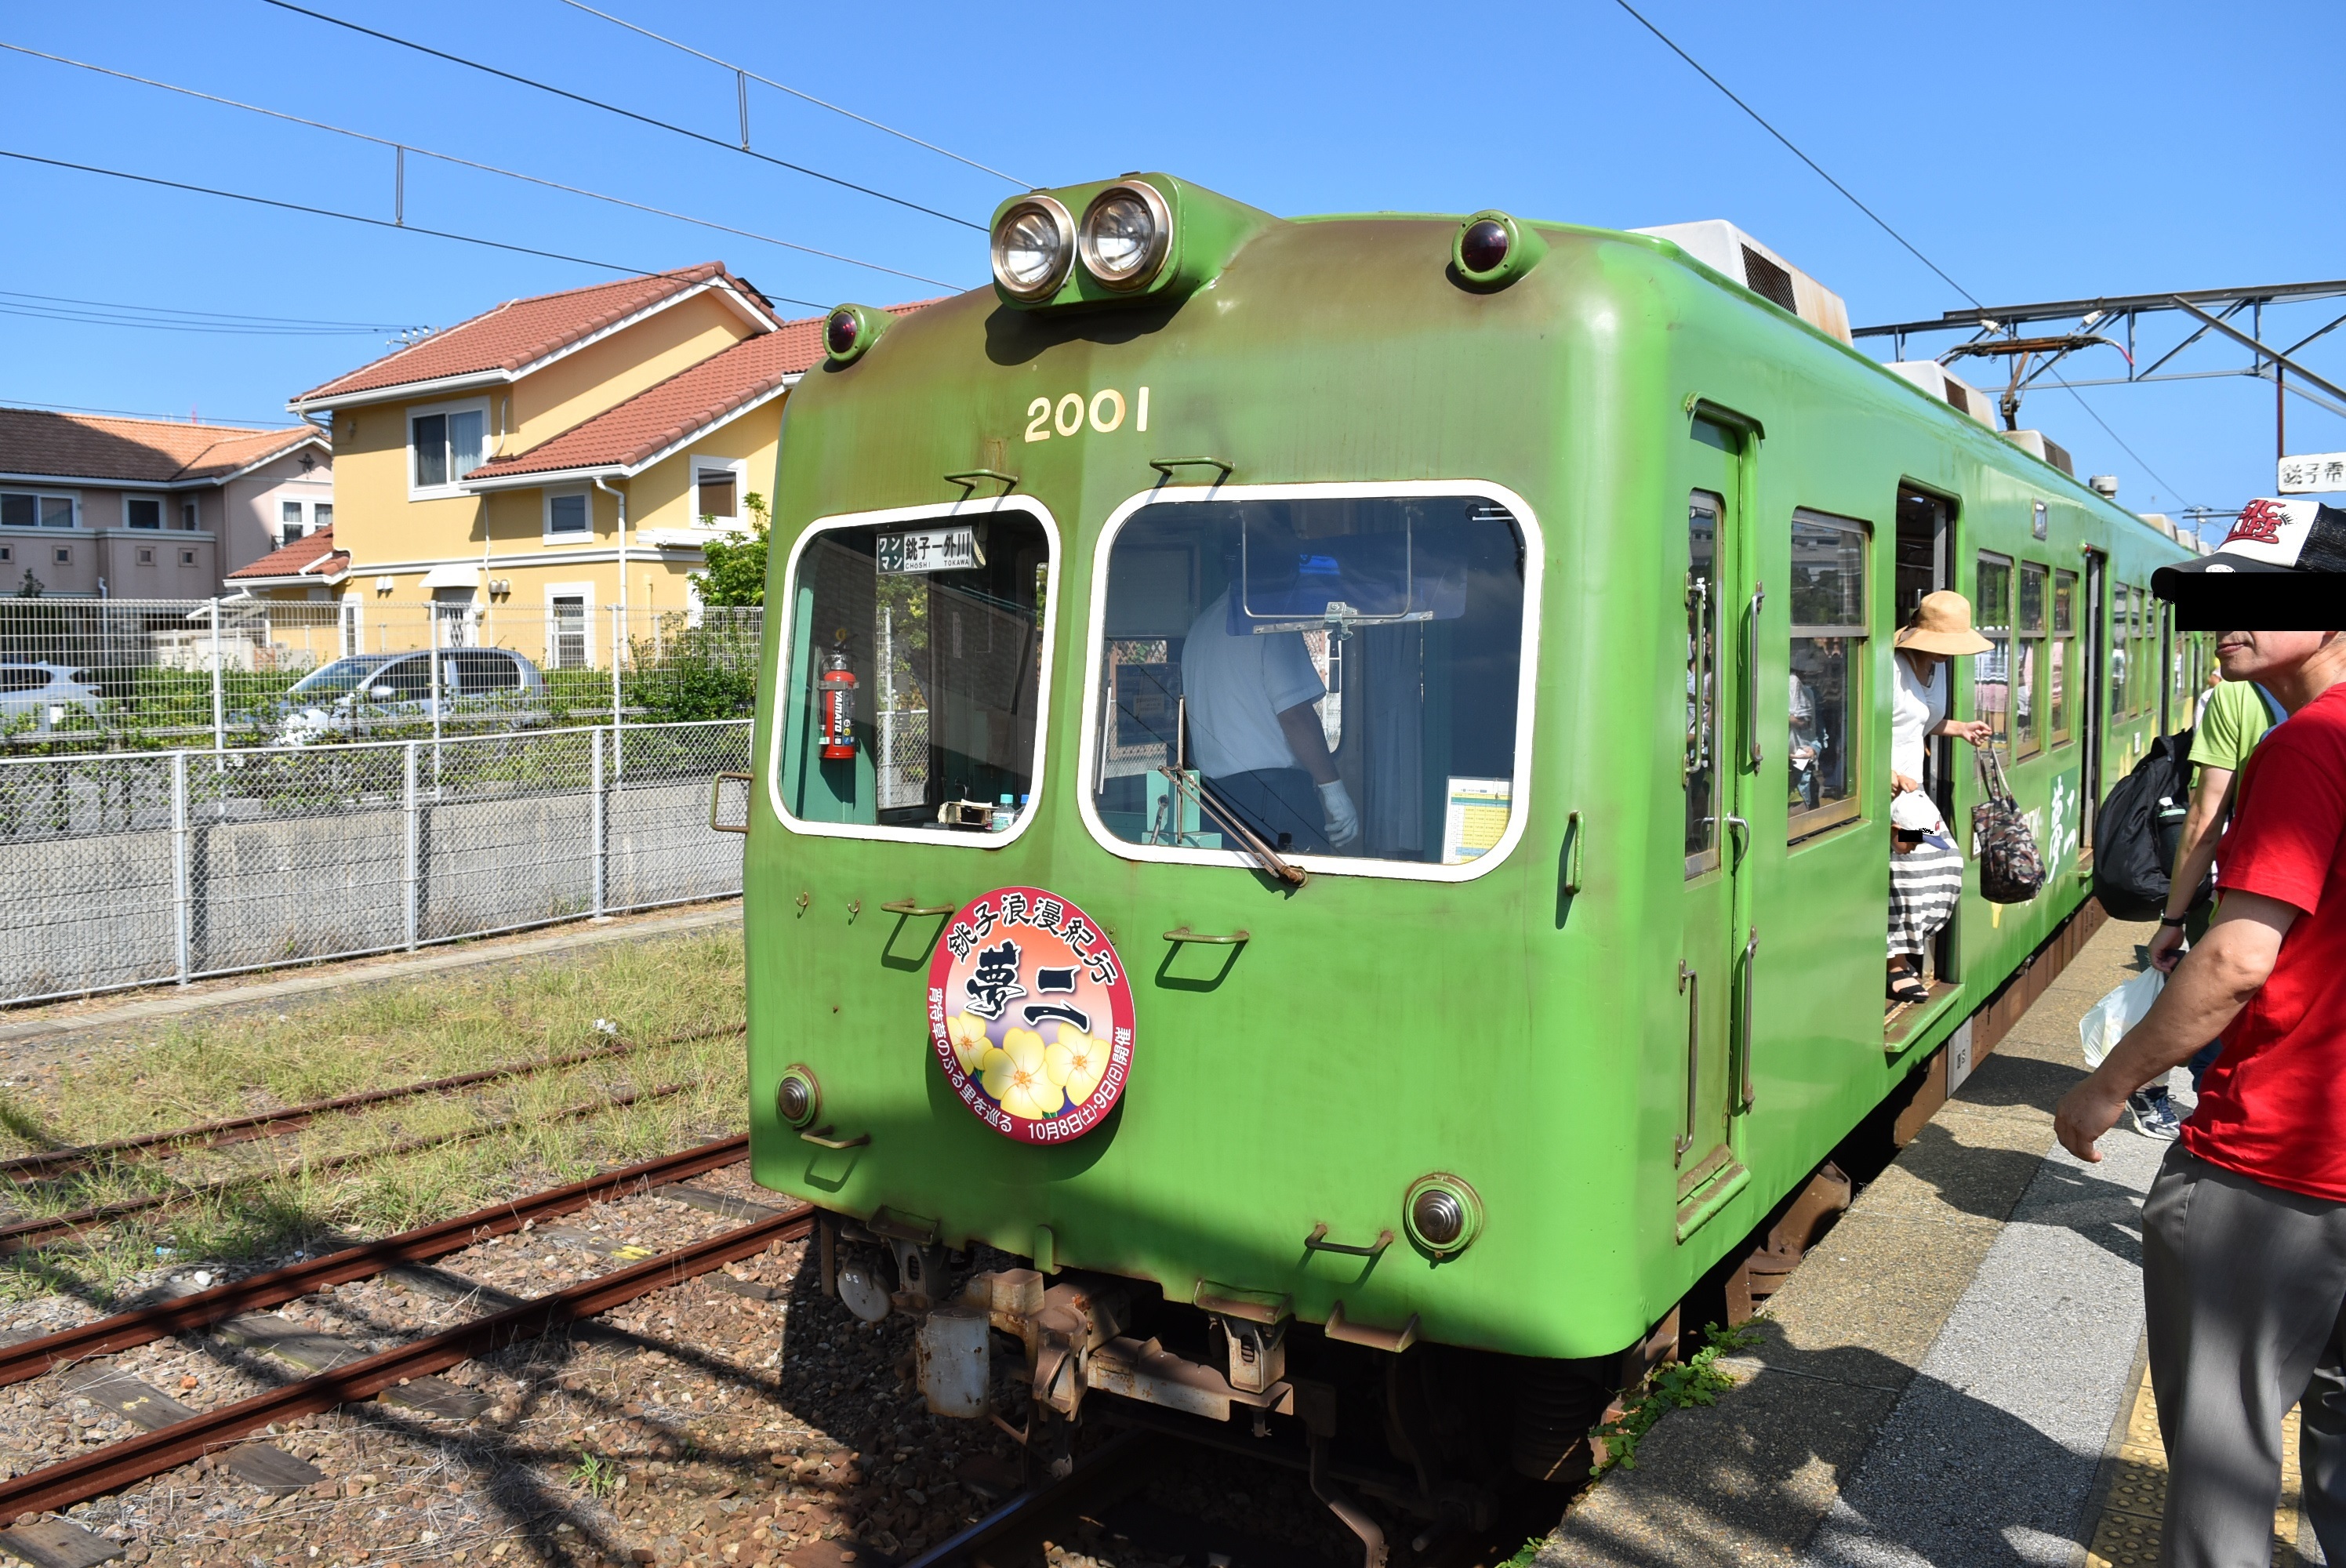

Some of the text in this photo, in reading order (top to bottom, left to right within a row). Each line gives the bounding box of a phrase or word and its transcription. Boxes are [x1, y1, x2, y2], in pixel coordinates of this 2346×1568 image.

[1025, 386, 1149, 443] 2001
[944, 557, 970, 567] TOKAWA
[834, 690, 843, 733] YAMATO
[947, 893, 1118, 985] 銚子浪漫紀行
